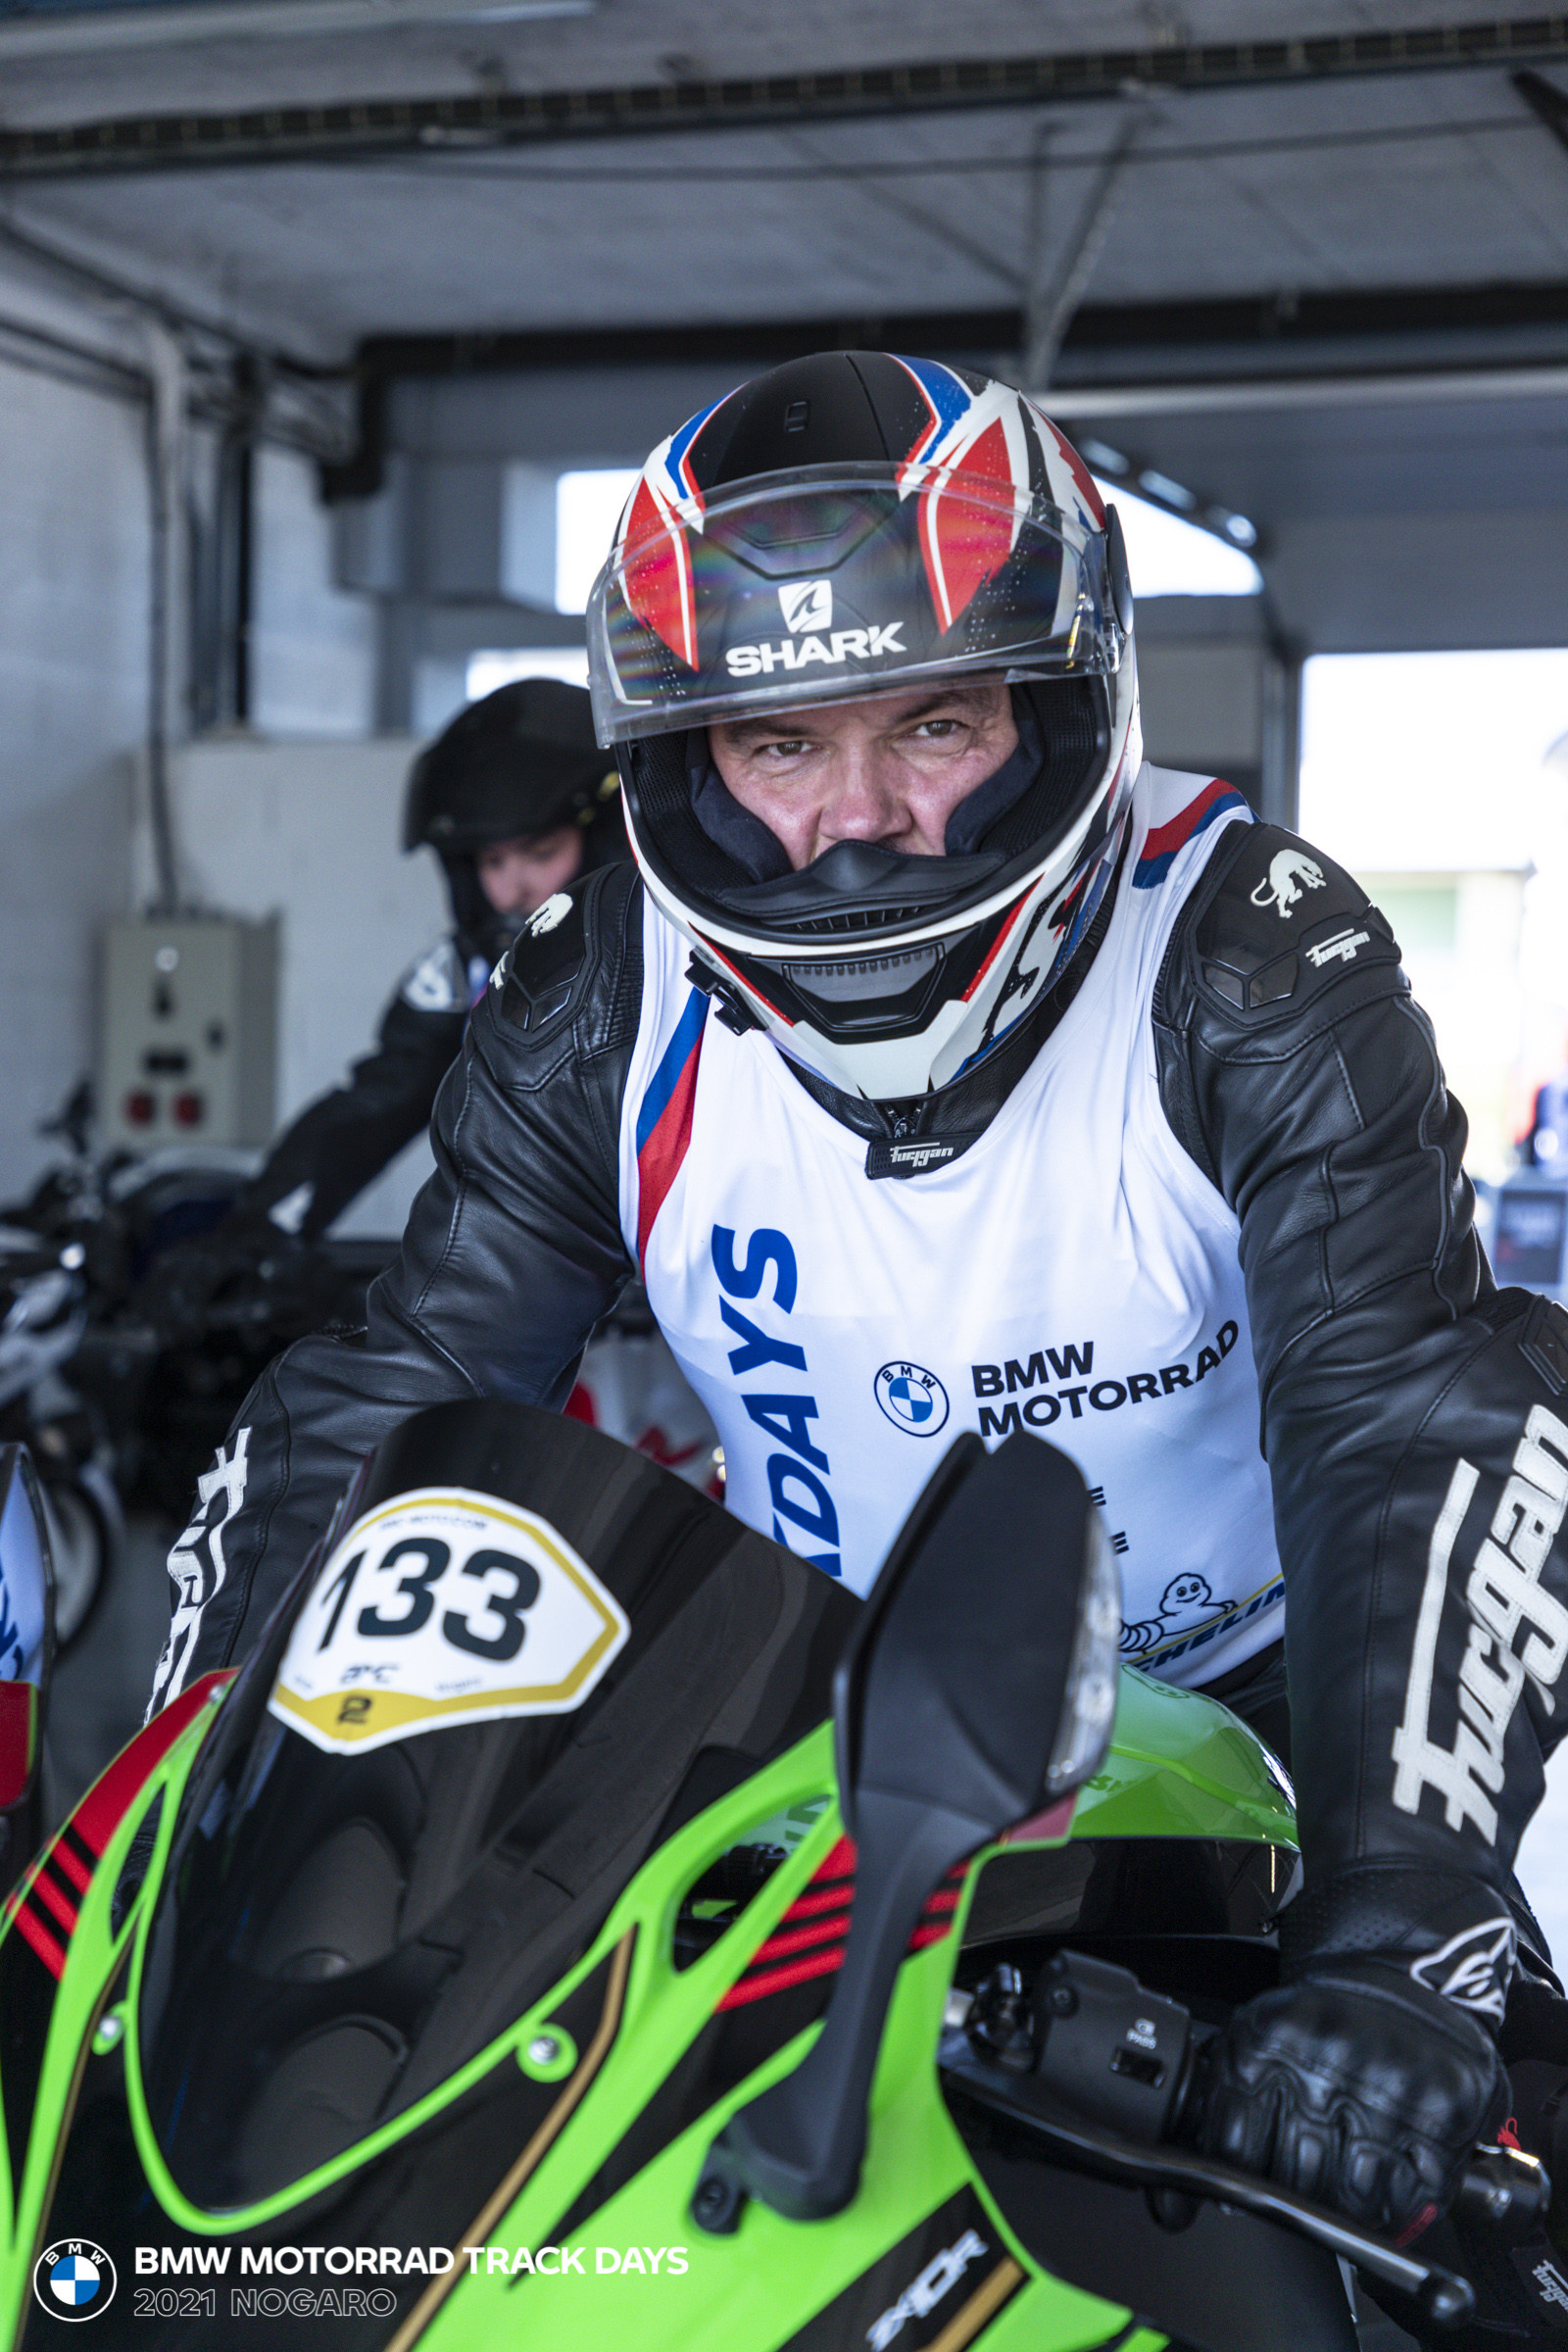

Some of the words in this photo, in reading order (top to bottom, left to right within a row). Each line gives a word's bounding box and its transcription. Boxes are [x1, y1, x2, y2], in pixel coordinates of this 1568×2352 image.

[725, 621, 907, 677] SHARK
[889, 1142, 955, 1168] Furygan
[971, 1340, 1095, 1398] BMW
[977, 1319, 1239, 1438] MOTORRAD
[317, 1537, 542, 1662] 133
[336, 1693, 374, 1725] 2
[1126, 2028, 1157, 2050] PASS
